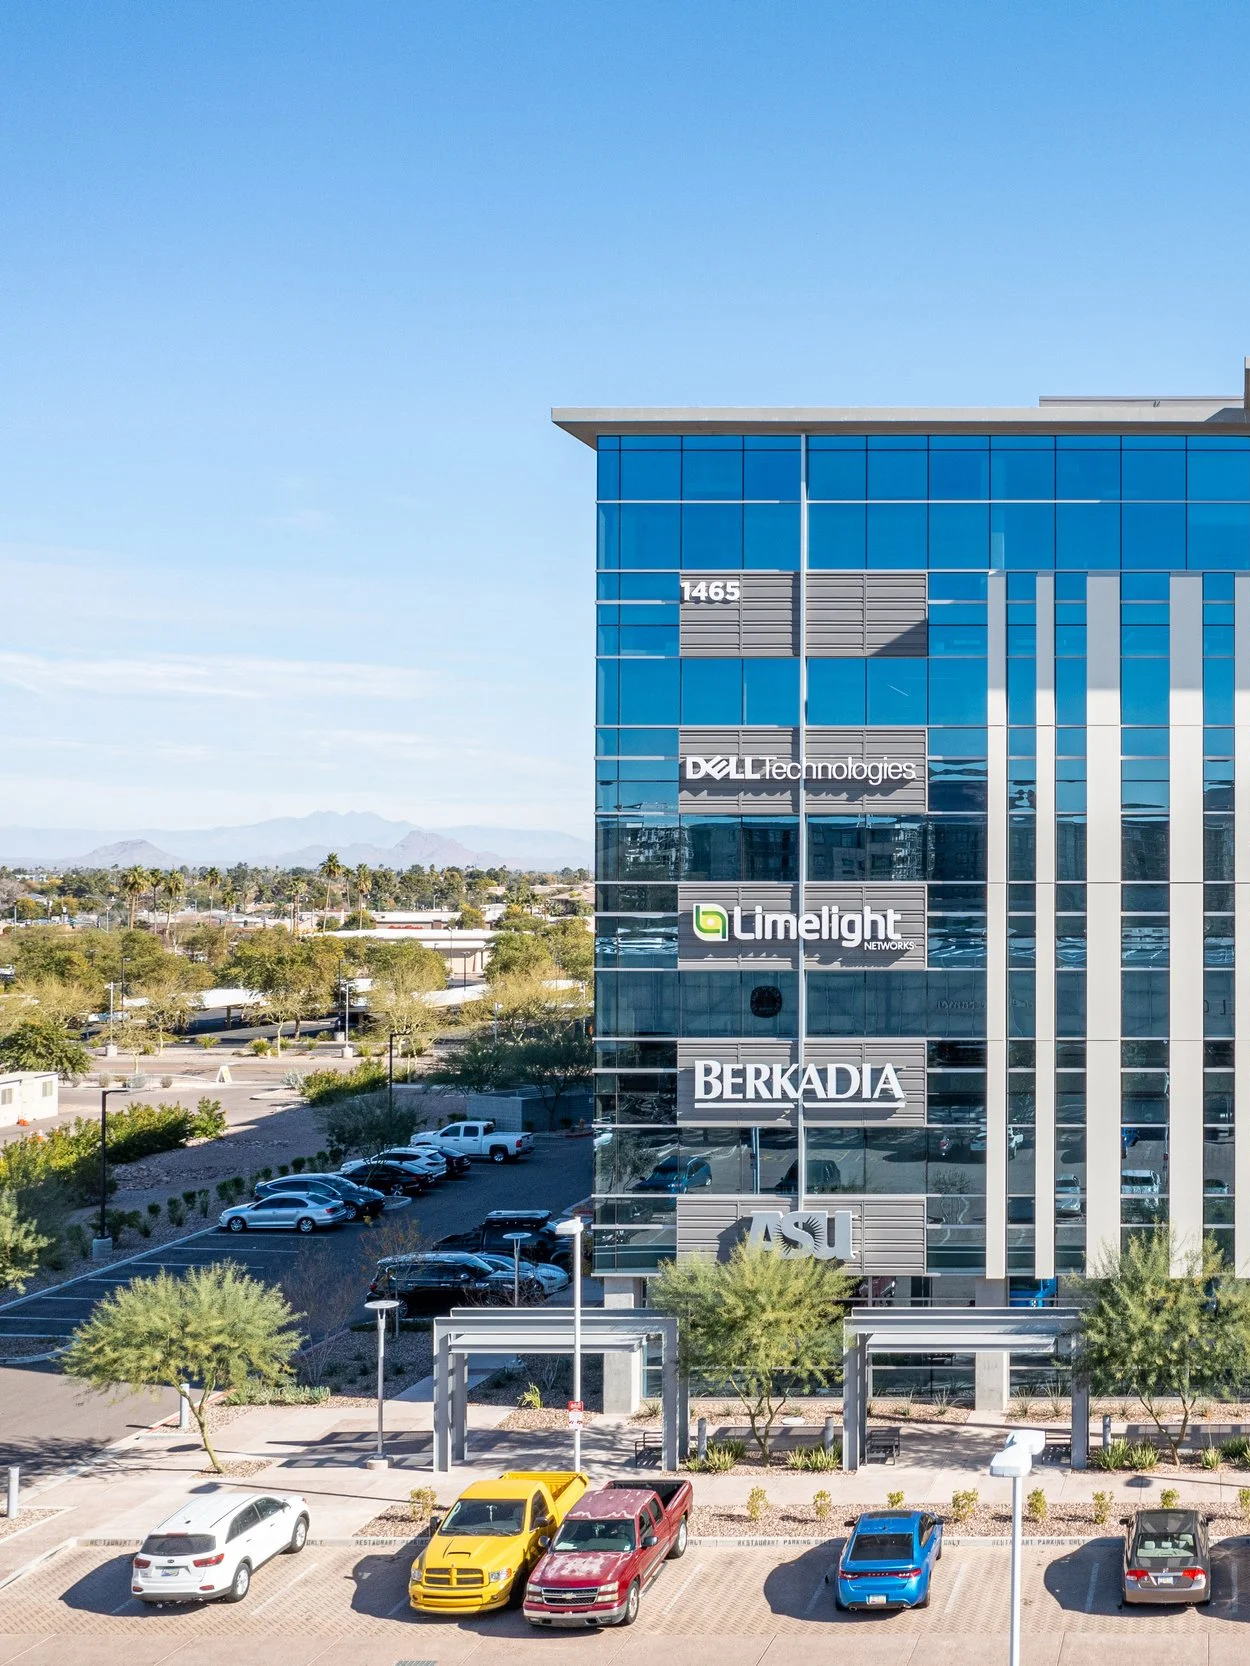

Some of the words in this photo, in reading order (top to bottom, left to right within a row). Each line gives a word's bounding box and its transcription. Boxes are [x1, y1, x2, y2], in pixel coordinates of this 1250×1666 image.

[680, 581, 740, 601] 1465
[686, 755, 760, 781] DELL
[759, 757, 916, 785] Technologies
[733, 905, 902, 947] Limelight
[864, 941, 915, 950] NETWORKS
[694, 1060, 906, 1099] BERKADIA
[749, 1210, 856, 1259] ASU
